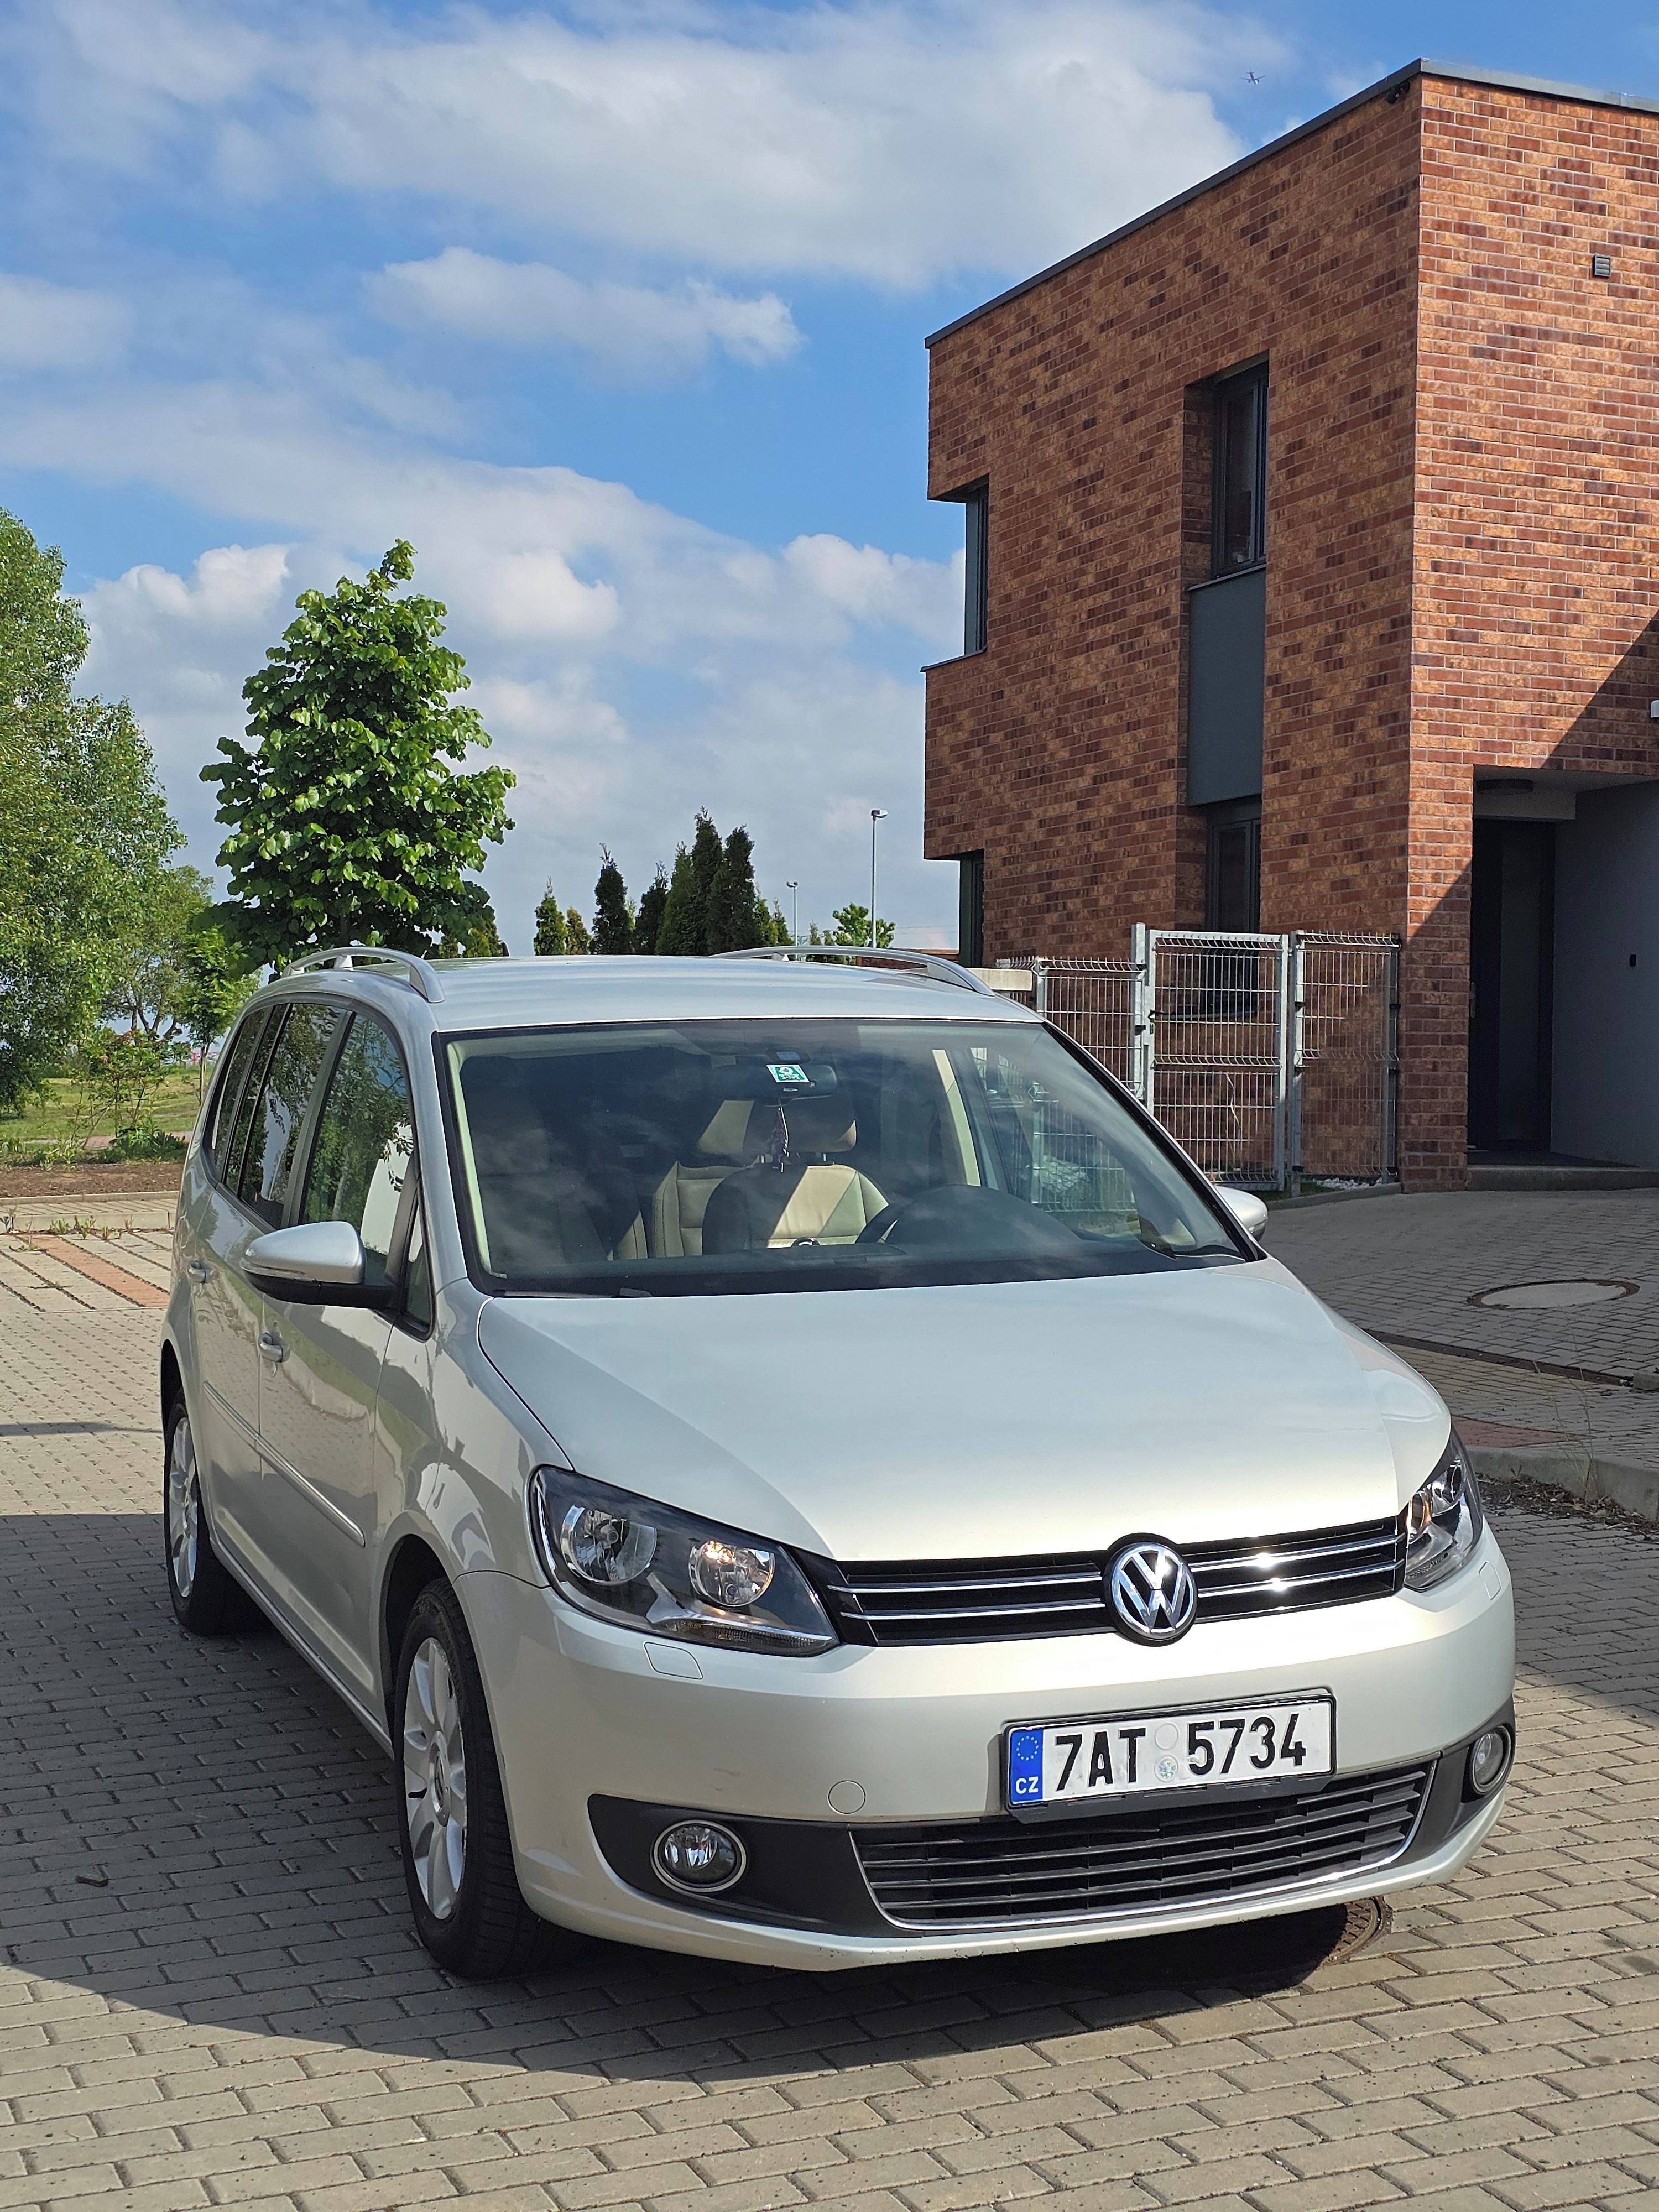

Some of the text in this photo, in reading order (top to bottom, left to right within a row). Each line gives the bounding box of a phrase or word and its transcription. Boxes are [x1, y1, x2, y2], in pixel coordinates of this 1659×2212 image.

[1113, 1544, 1192, 1635] VW
[1016, 1776, 1039, 1794] CZ
[1055, 1713, 1307, 1792] 7AT 5734
